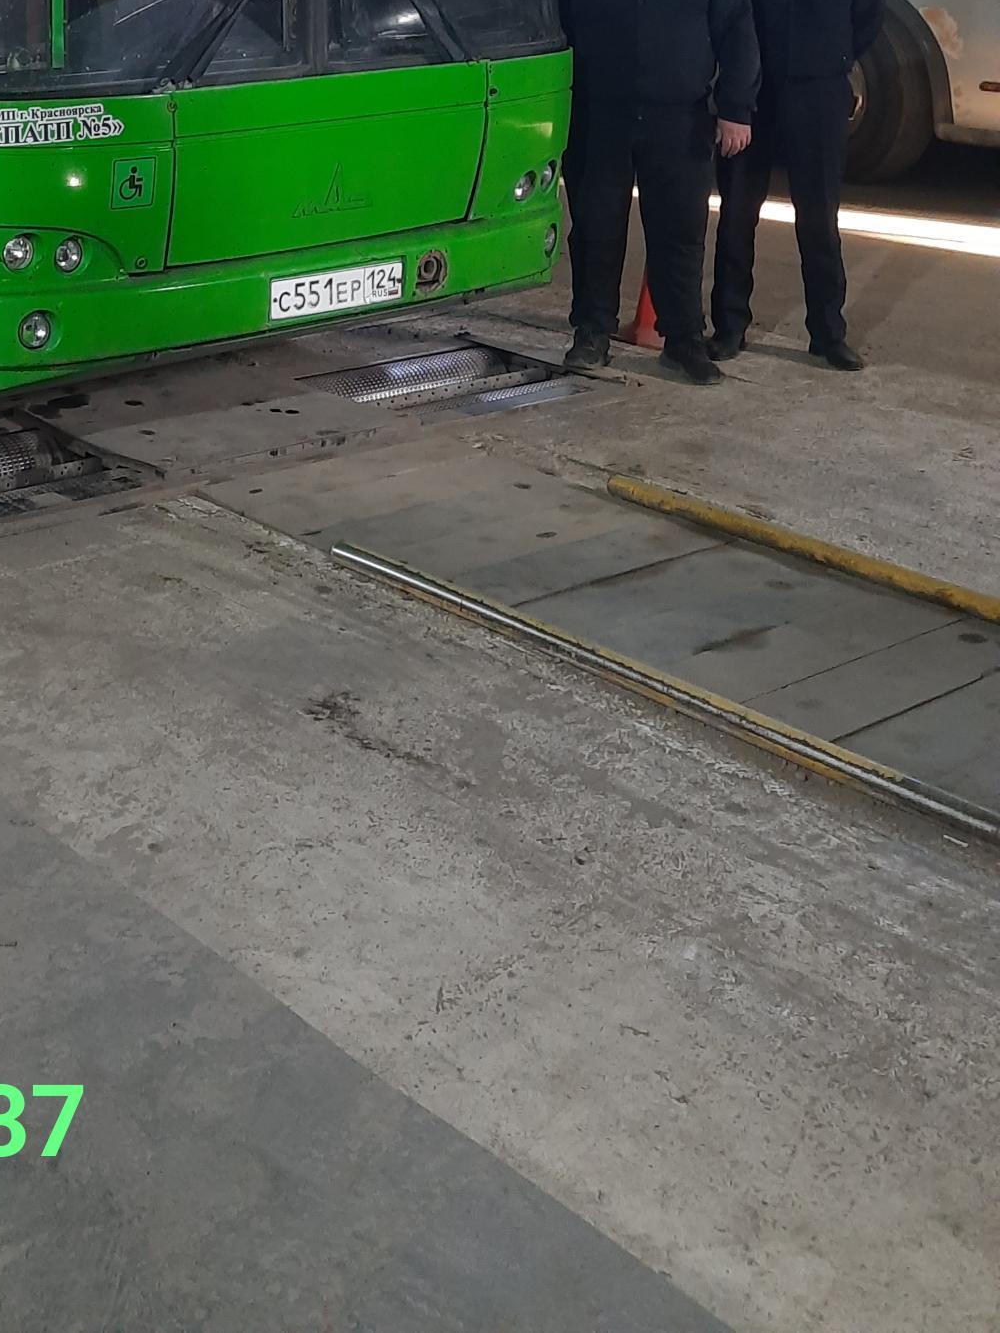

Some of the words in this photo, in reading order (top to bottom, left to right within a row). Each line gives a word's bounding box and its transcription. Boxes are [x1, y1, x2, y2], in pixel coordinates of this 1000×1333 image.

[20, 112, 28, 120] г.
[31, 105, 102, 121] Красноярска
[79, 116, 123, 139] №5»
[278, 277, 361, 312] С551ЕР
[366, 266, 396, 290] 124
[371, 289, 388, 297] RUS
